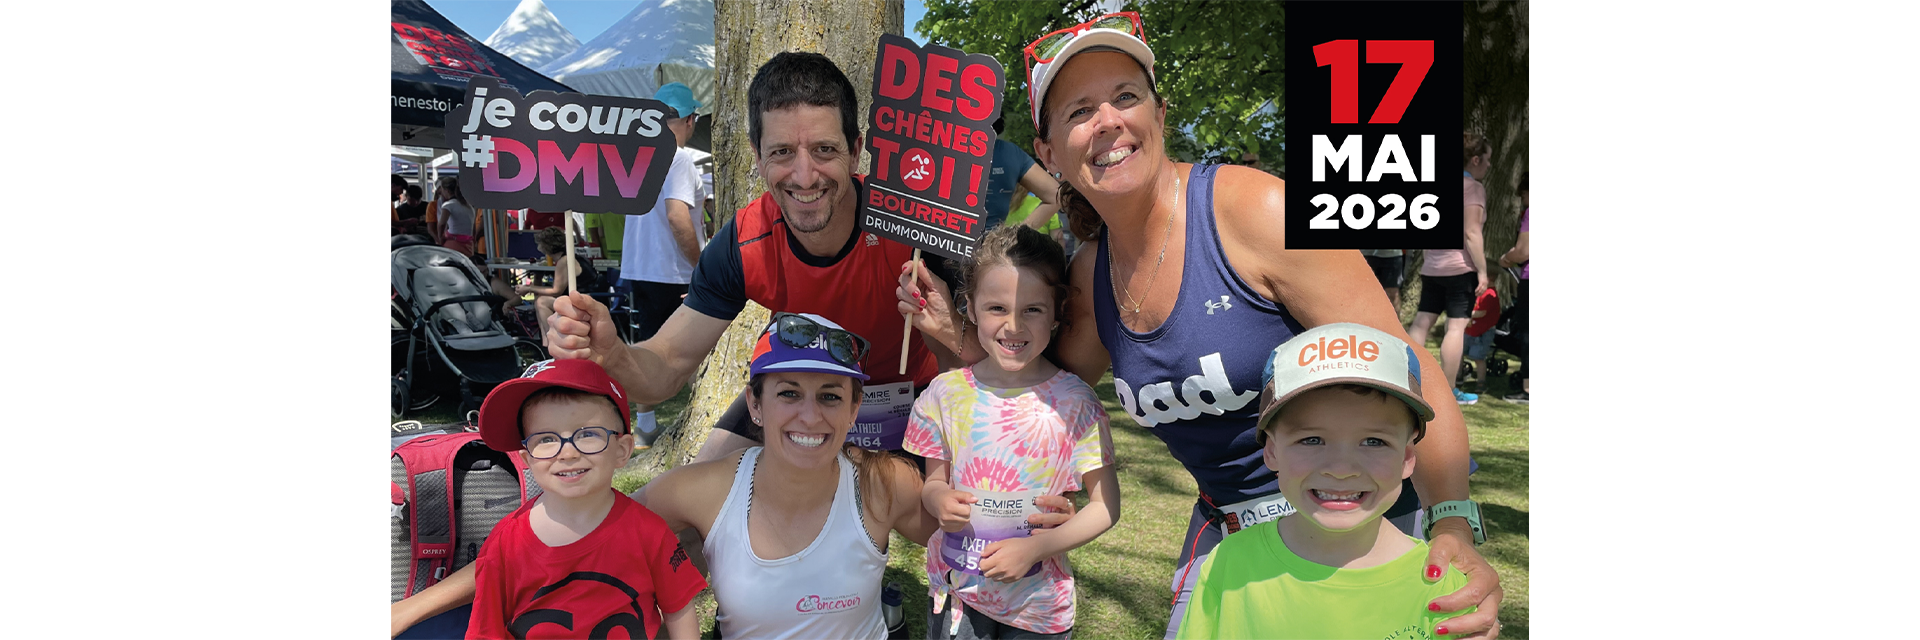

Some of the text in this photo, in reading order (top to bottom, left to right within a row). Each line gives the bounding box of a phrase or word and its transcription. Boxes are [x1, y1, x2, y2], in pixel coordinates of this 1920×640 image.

[879, 43, 997, 121] DES
[461, 87, 665, 138] je cours
[875, 106, 989, 157] CHÊNES
[461, 134, 657, 199] #DMV
[869, 188, 978, 234] BOURRET
[865, 214, 974, 258] DRUMMONDVILLE
[1298, 335, 1380, 367] ciele
[1309, 362, 1369, 374] ATHLETICS
[862, 390, 890, 399] MIRE
[1258, 501, 1294, 518] LEM
[955, 554, 982, 570] 45
[961, 535, 997, 553] AXEL
